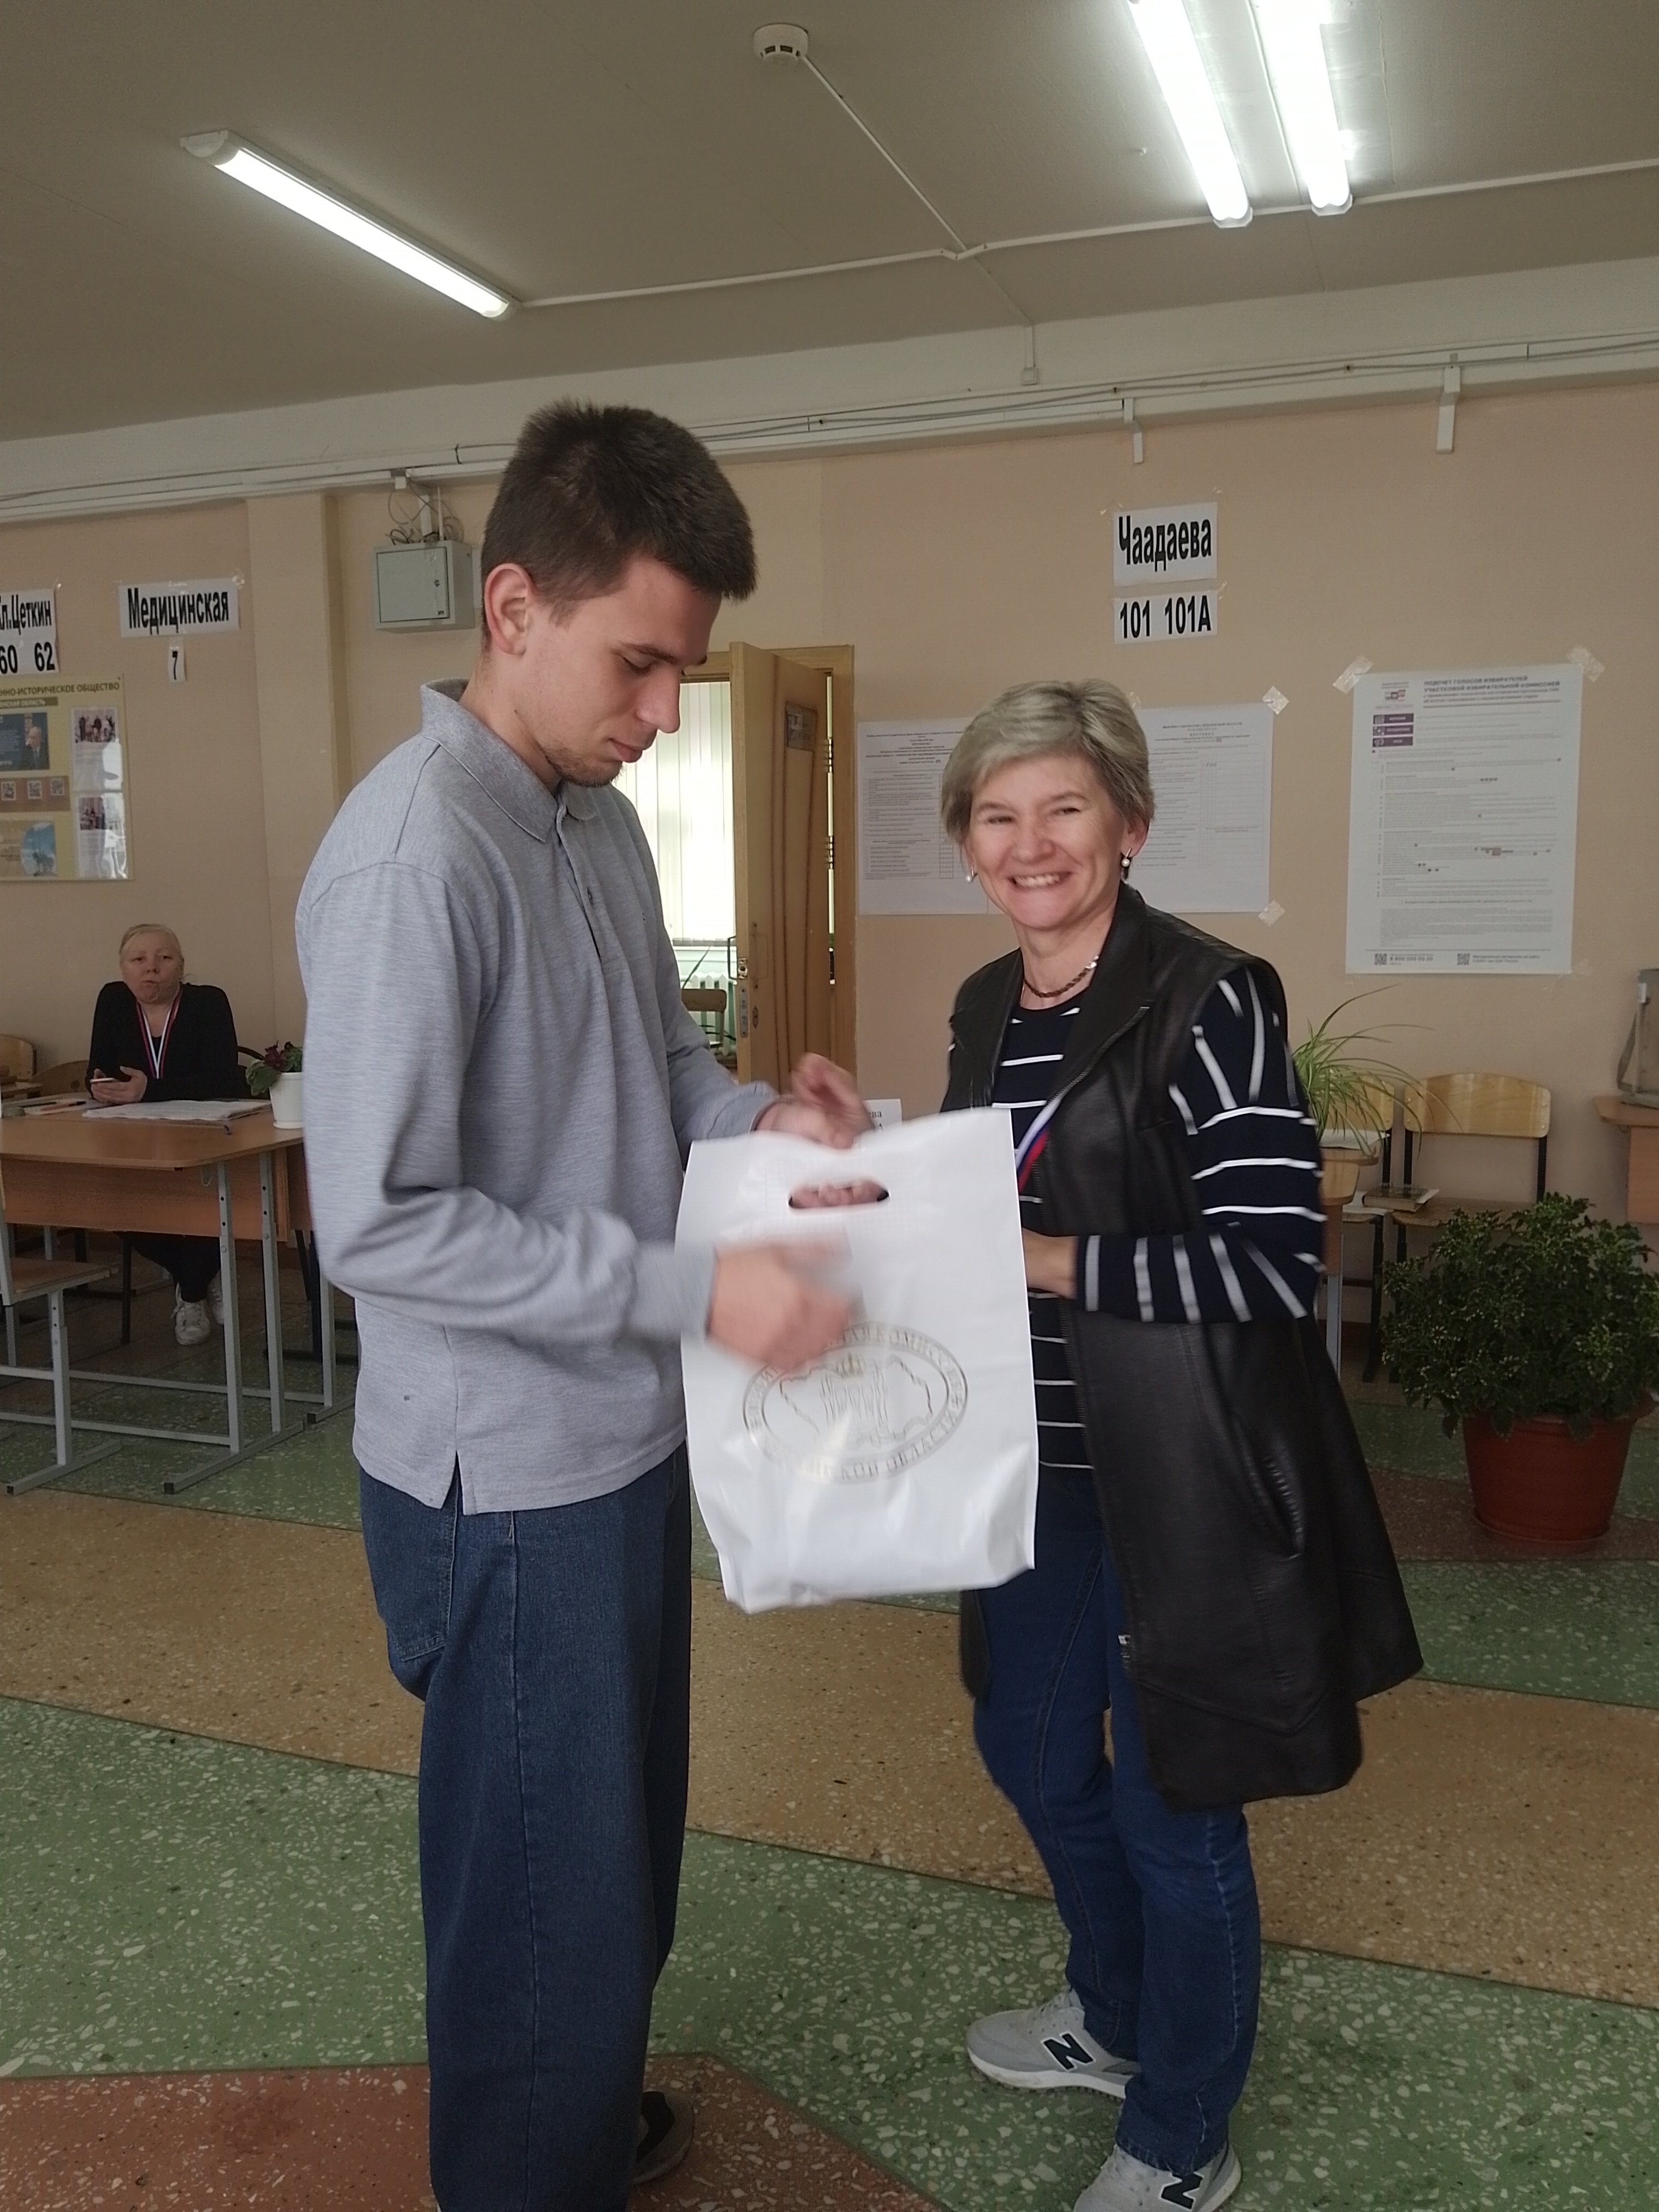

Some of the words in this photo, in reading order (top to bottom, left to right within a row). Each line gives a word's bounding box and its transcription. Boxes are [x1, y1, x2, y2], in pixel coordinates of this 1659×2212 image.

[1119, 515, 1212, 572] Чаадаева
[0, 594, 52, 635] л.Цеткин
[127, 588, 229, 635] Медицинская
[1120, 600, 1150, 638] 101
[1164, 595, 1212, 635] 101А
[0, 644, 18, 674] 60
[34, 641, 55, 671] 62
[172, 650, 179, 680] 7
[77, 682, 120, 693] ОБЩЕСТВО
[1042, 2032, 1095, 2070] N
